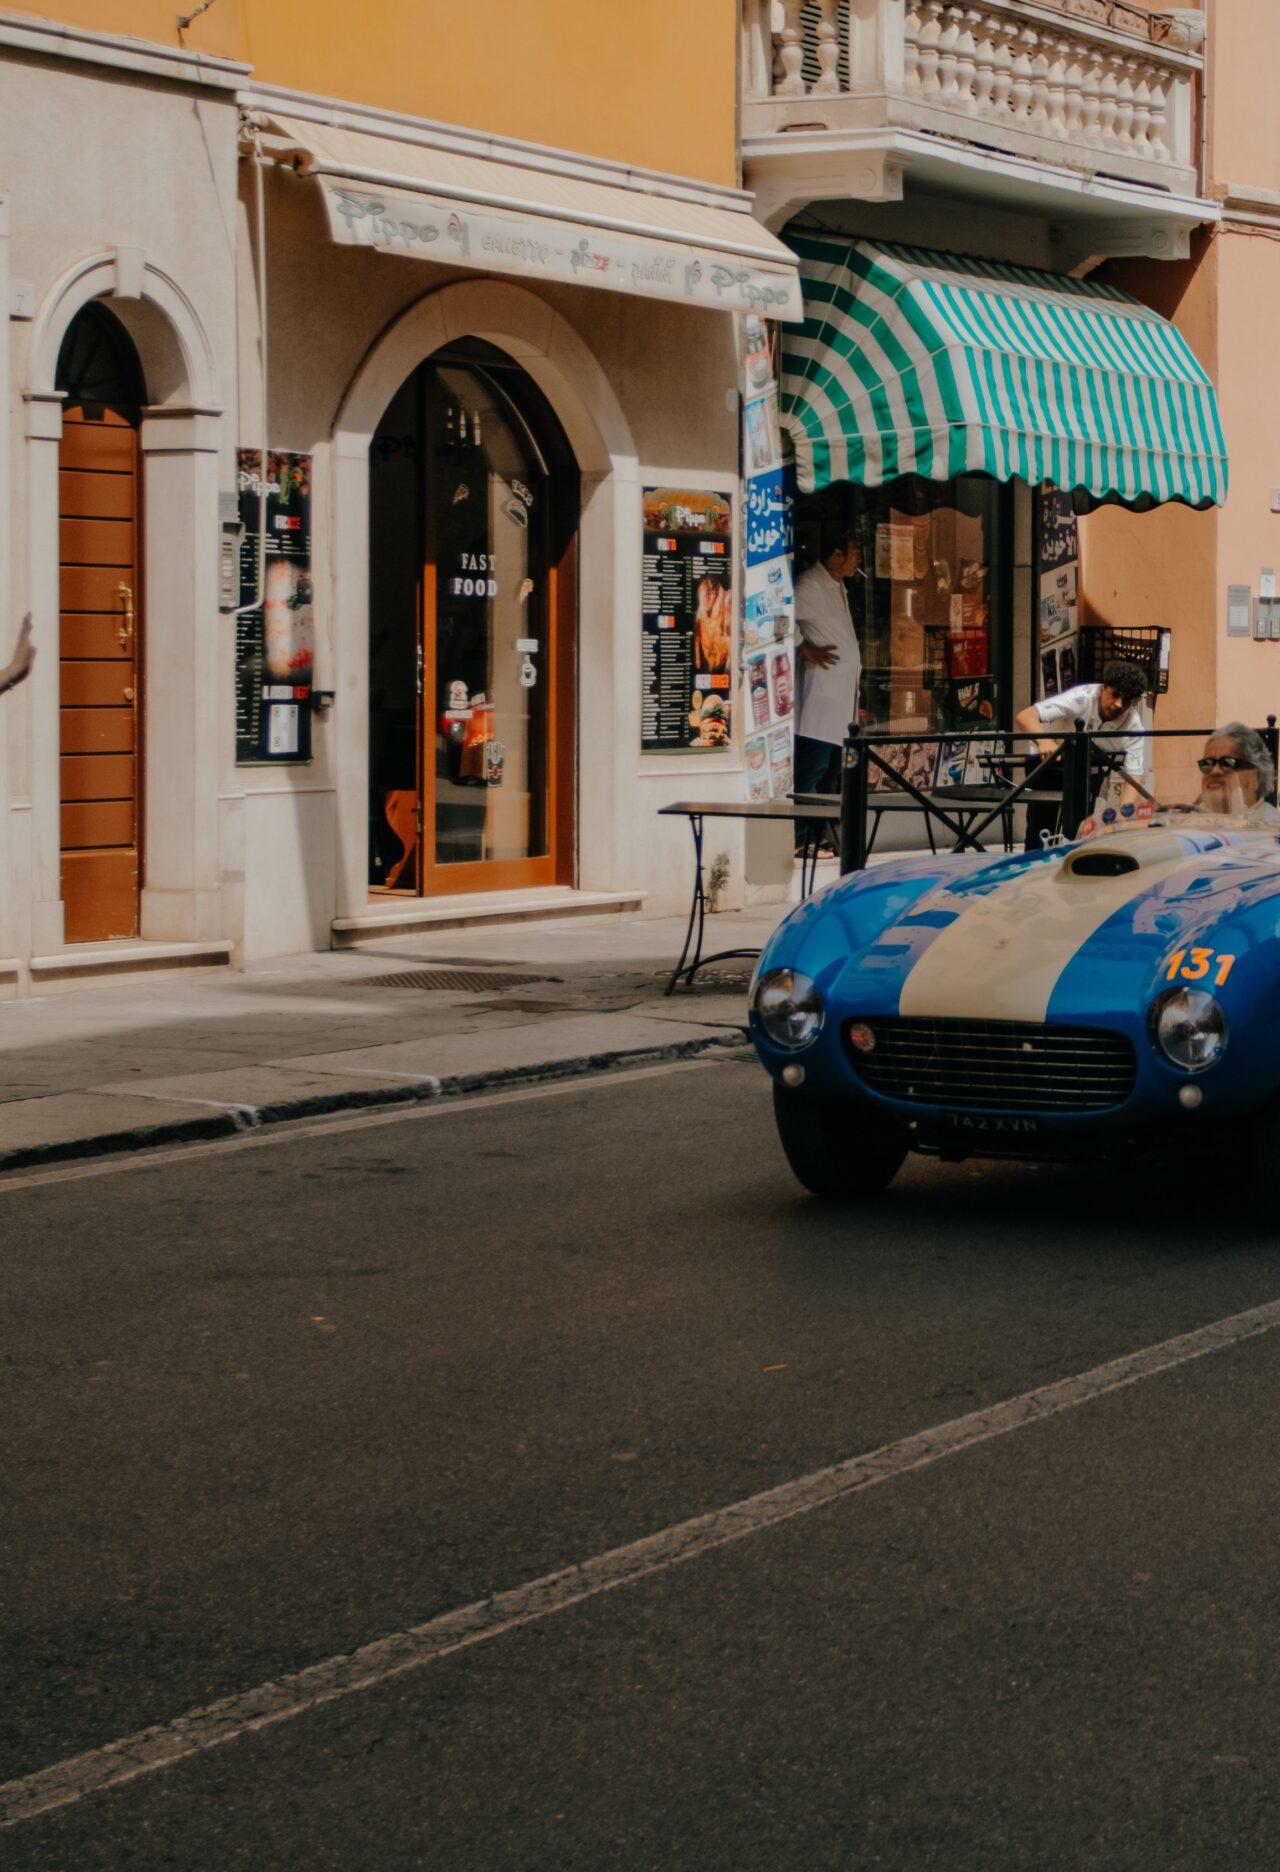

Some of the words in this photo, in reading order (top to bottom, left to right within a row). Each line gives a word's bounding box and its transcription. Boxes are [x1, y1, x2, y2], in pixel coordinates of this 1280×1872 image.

[333, 190, 439, 249] Pippo
[710, 263, 790, 311] Pippo
[461, 553, 497, 571] FAST
[453, 578, 499, 597] FOOD
[1166, 947, 1235, 986] 131
